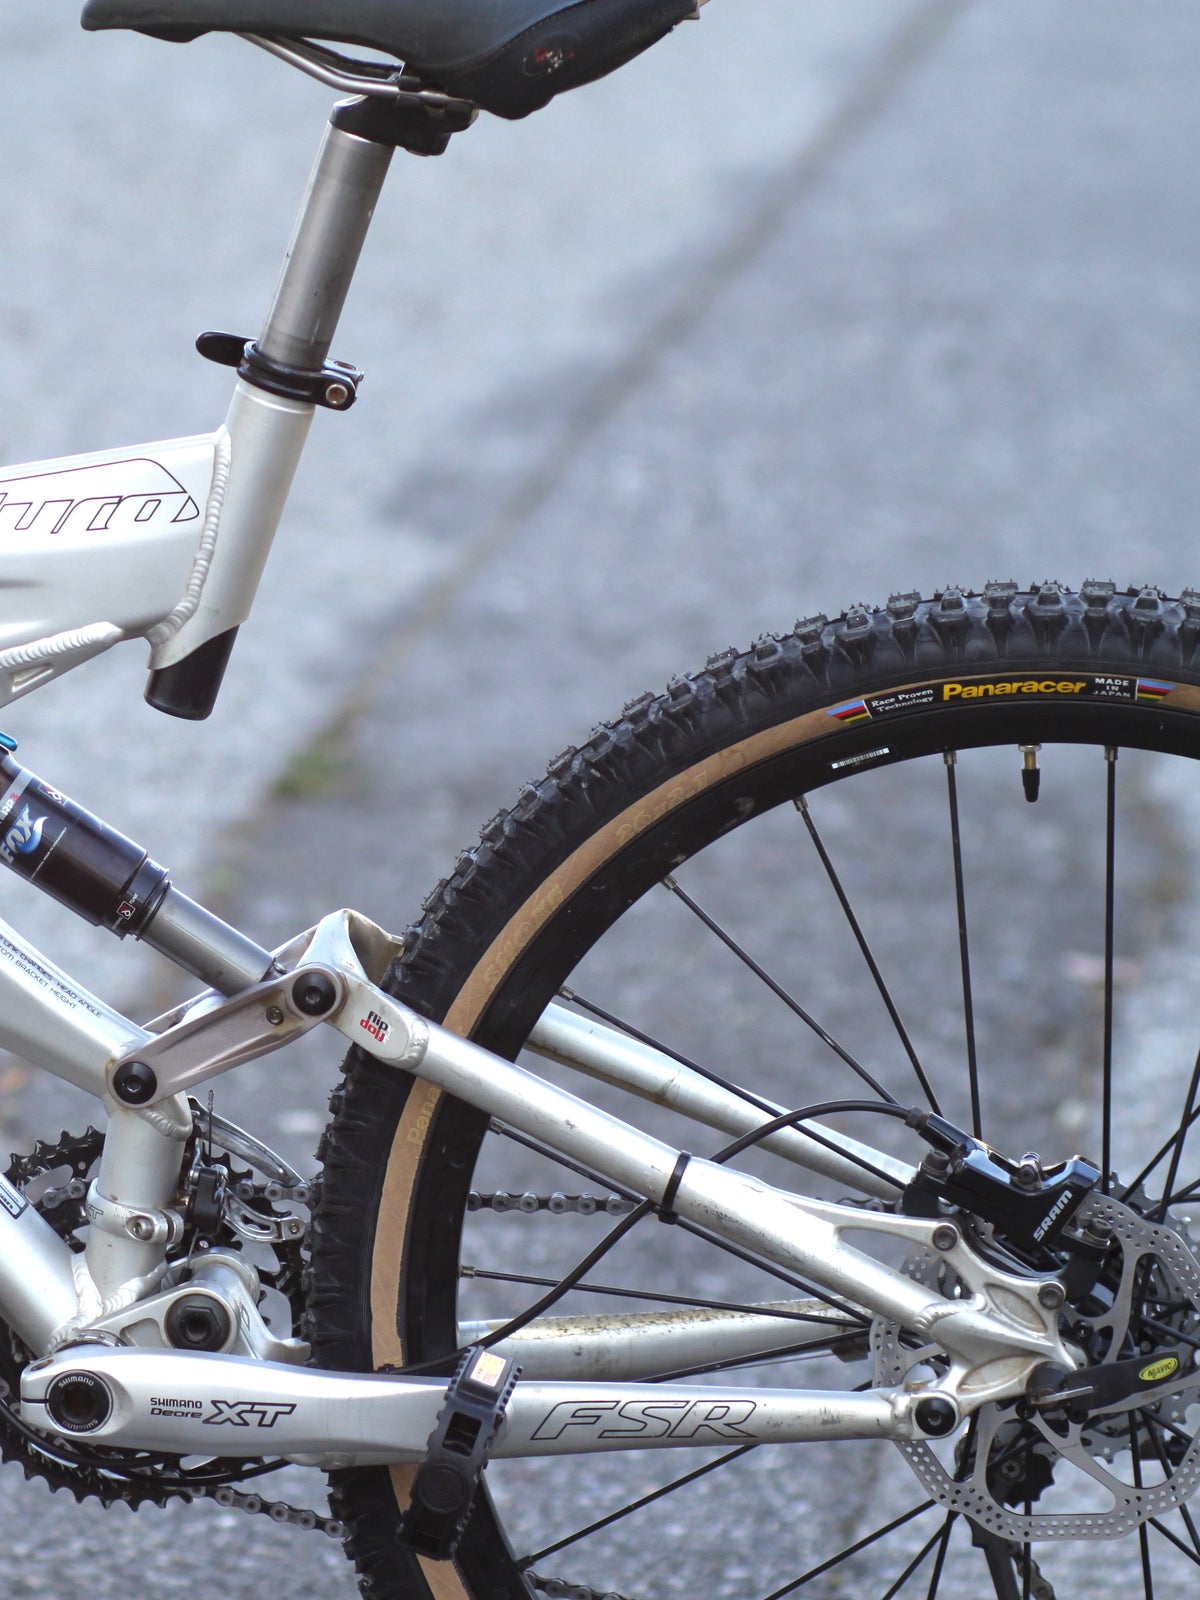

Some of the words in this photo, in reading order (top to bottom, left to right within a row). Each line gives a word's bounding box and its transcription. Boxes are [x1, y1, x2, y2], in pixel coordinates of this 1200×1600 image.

[943, 681, 1086, 701] Panaracer
[1095, 677, 1130, 687] MADE
[871, 697, 896, 708] Race
[898, 689, 934, 700] Proven
[1092, 690, 1131, 698] JAPAN
[877, 696, 934, 713] Technology
[15, 959, 49, 988] BRACKET
[50, 987, 77, 1010] HEIGHT
[56, 981, 78, 1000] HEAD
[78, 999, 102, 1018] ANGLE
[367, 1010, 389, 1032] flip
[1033, 1190, 1073, 1242] SRAM
[1147, 1361, 1173, 1378] MAVIC
[58, 1376, 95, 1387] SHIMANO
[150, 1397, 203, 1409] SHIMANO
[150, 1407, 203, 1419] Deore
[202, 1399, 297, 1428] XT
[530, 1400, 758, 1440] FSR
